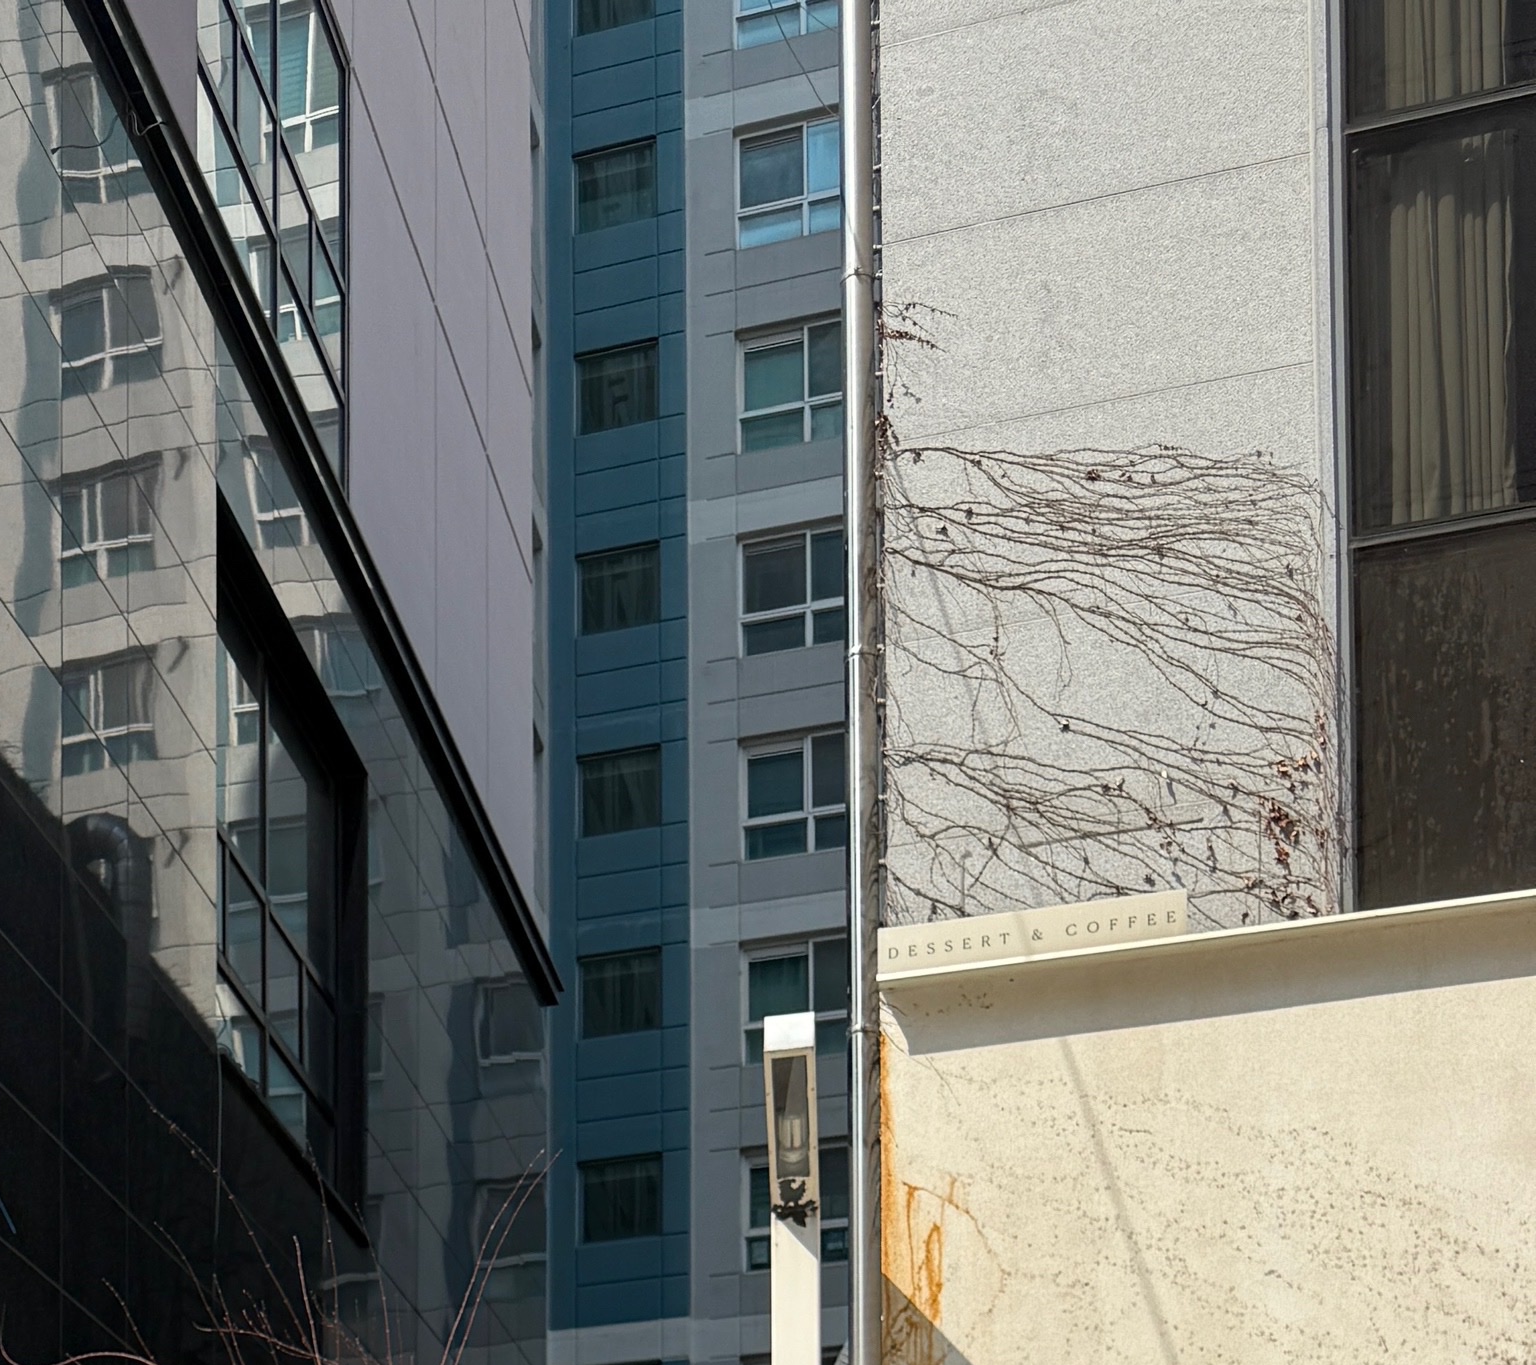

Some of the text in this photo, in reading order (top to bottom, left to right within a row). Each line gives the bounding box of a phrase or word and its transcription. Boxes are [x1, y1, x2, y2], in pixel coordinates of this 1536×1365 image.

[887, 910, 1177, 960] DESSERT & COFFEE
